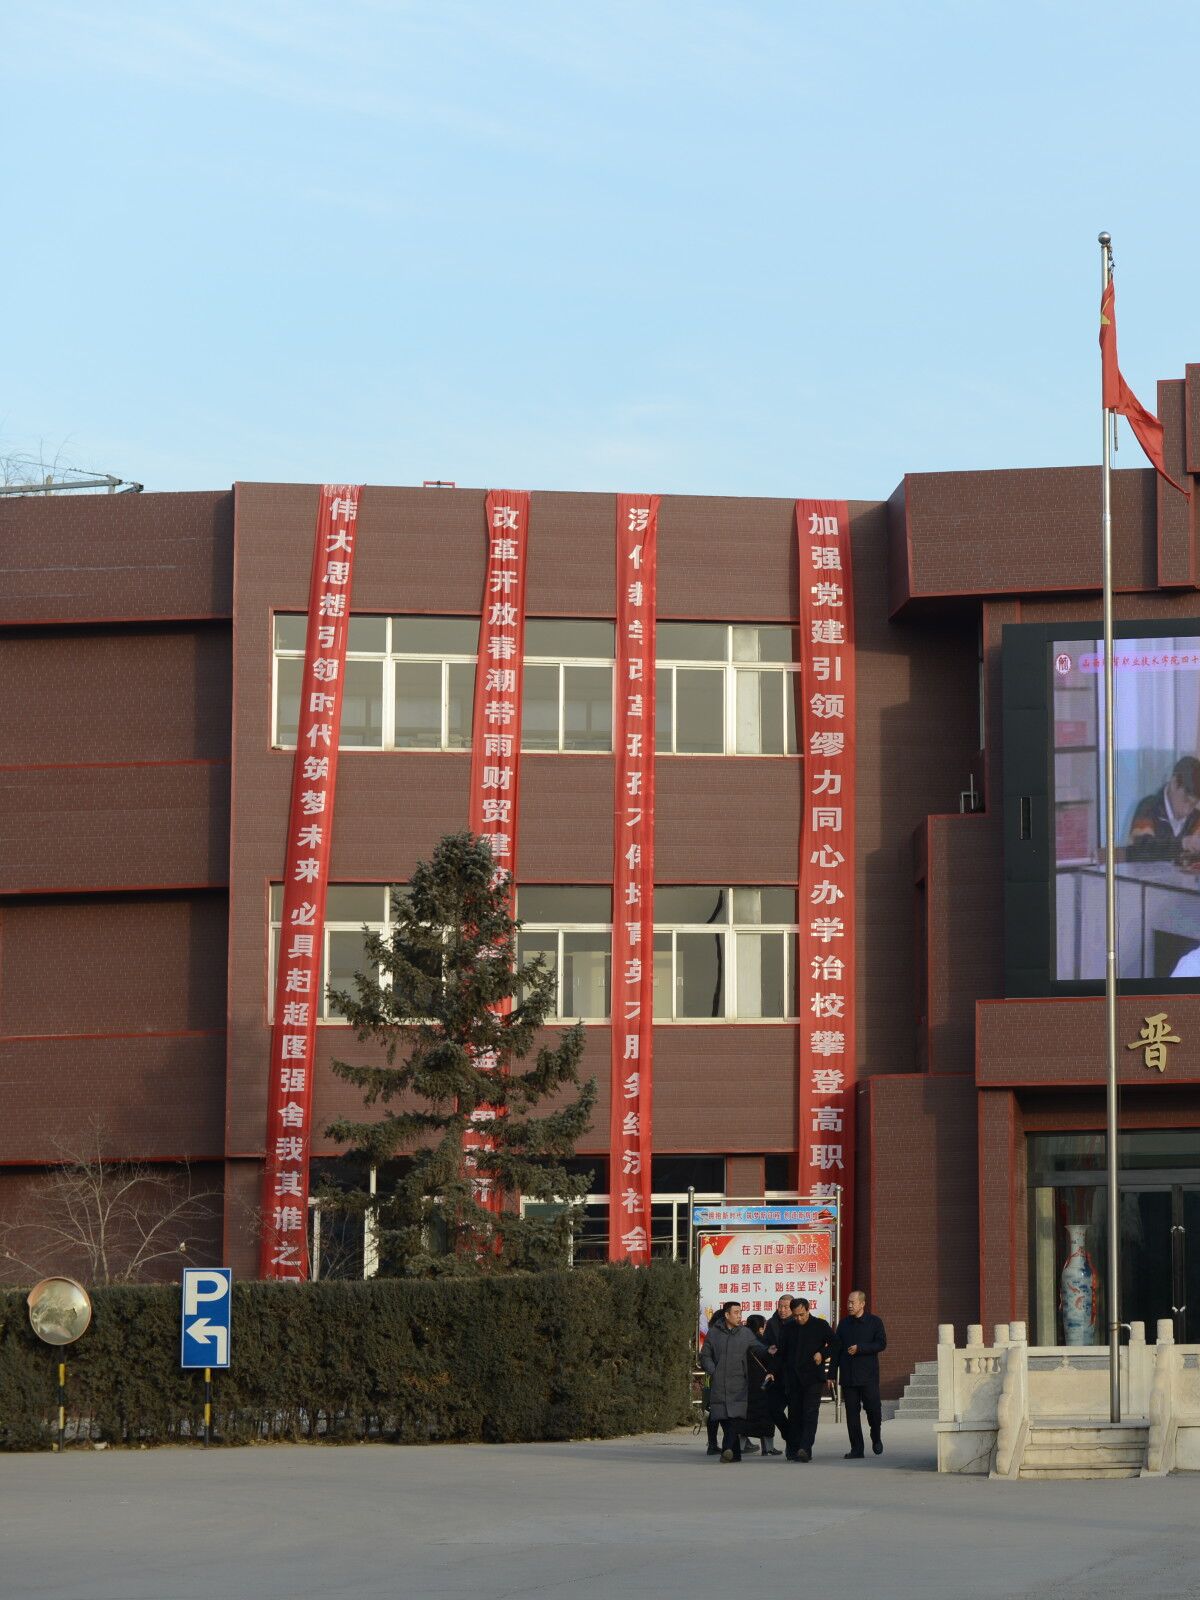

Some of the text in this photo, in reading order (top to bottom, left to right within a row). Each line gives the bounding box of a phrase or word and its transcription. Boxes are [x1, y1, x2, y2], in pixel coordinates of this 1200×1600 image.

[271, 497, 357, 1279] 伟大思想引领时代筑梦未来必具赶超图强舍我其谁之
[742, 1243, 818, 1256] 在习近平新时代
[719, 1262, 817, 1275] 中国特色社会主义思
[185, 1271, 229, 1316] P
